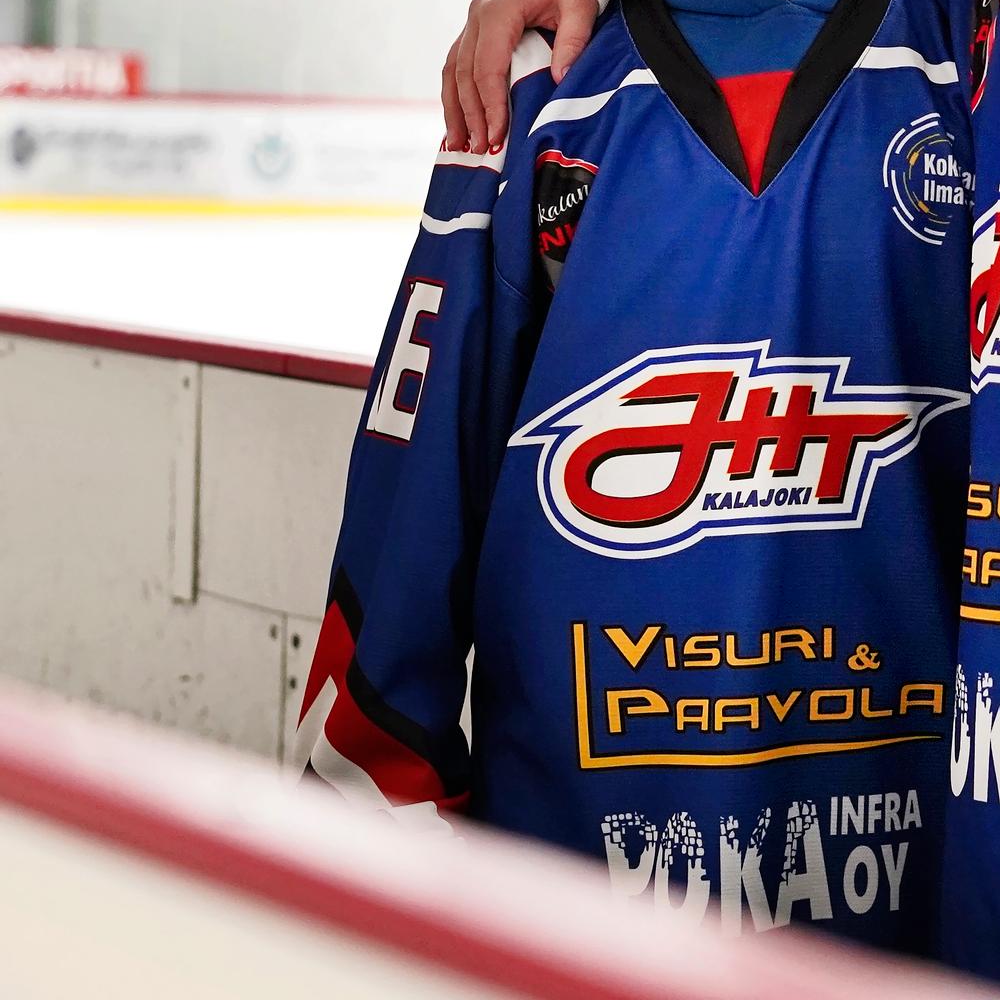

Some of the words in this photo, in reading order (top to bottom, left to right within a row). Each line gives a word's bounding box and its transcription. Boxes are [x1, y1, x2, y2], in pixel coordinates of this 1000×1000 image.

[702, 487, 812, 511] KALAJOKI
[604, 625, 833, 671] VISURI
[848, 643, 881, 671] &
[605, 683, 944, 734] PAAVOLA
[829, 789, 923, 836] INFRA
[843, 842, 909, 915] OY
